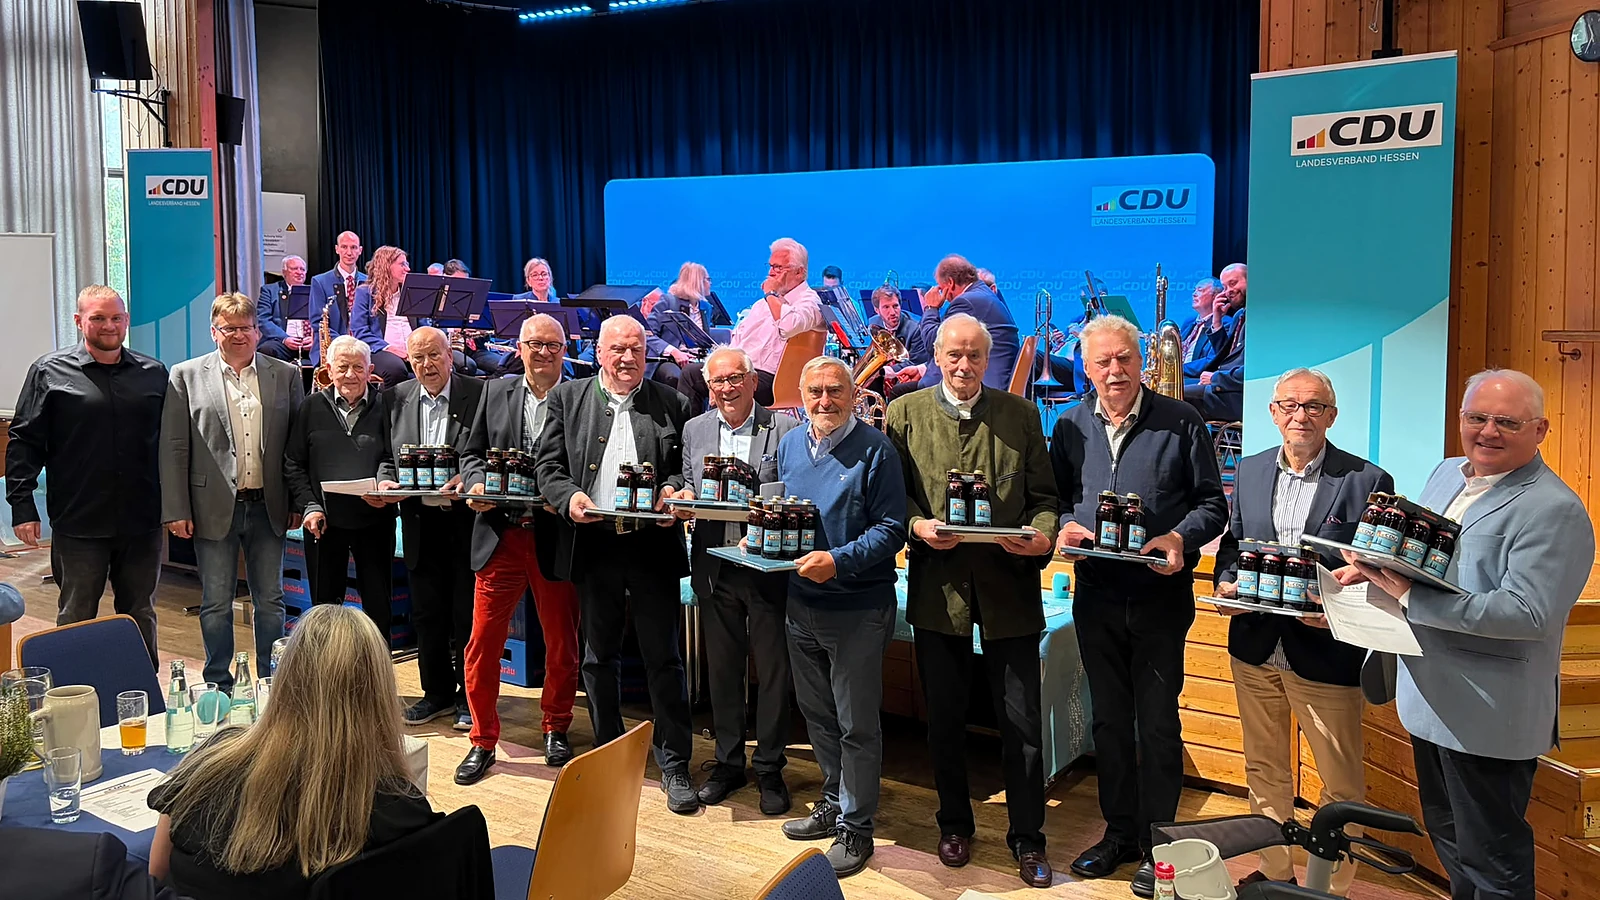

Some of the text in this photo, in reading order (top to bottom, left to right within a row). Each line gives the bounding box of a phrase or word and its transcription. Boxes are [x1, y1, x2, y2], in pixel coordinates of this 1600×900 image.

[1329, 109, 1436, 146] CDU
[1295, 152, 1420, 168] LANDESVERBAND HESSEN
[162, 179, 205, 195] CDU
[1118, 188, 1190, 210] CDU
[1094, 216, 1187, 226] LANDESVERBAND HESSEN
[1020, 270, 1045, 279] CDU
[1103, 271, 1132, 279] CDU
[1036, 281, 1064, 290] CDU
[1122, 281, 1151, 290] CDU
